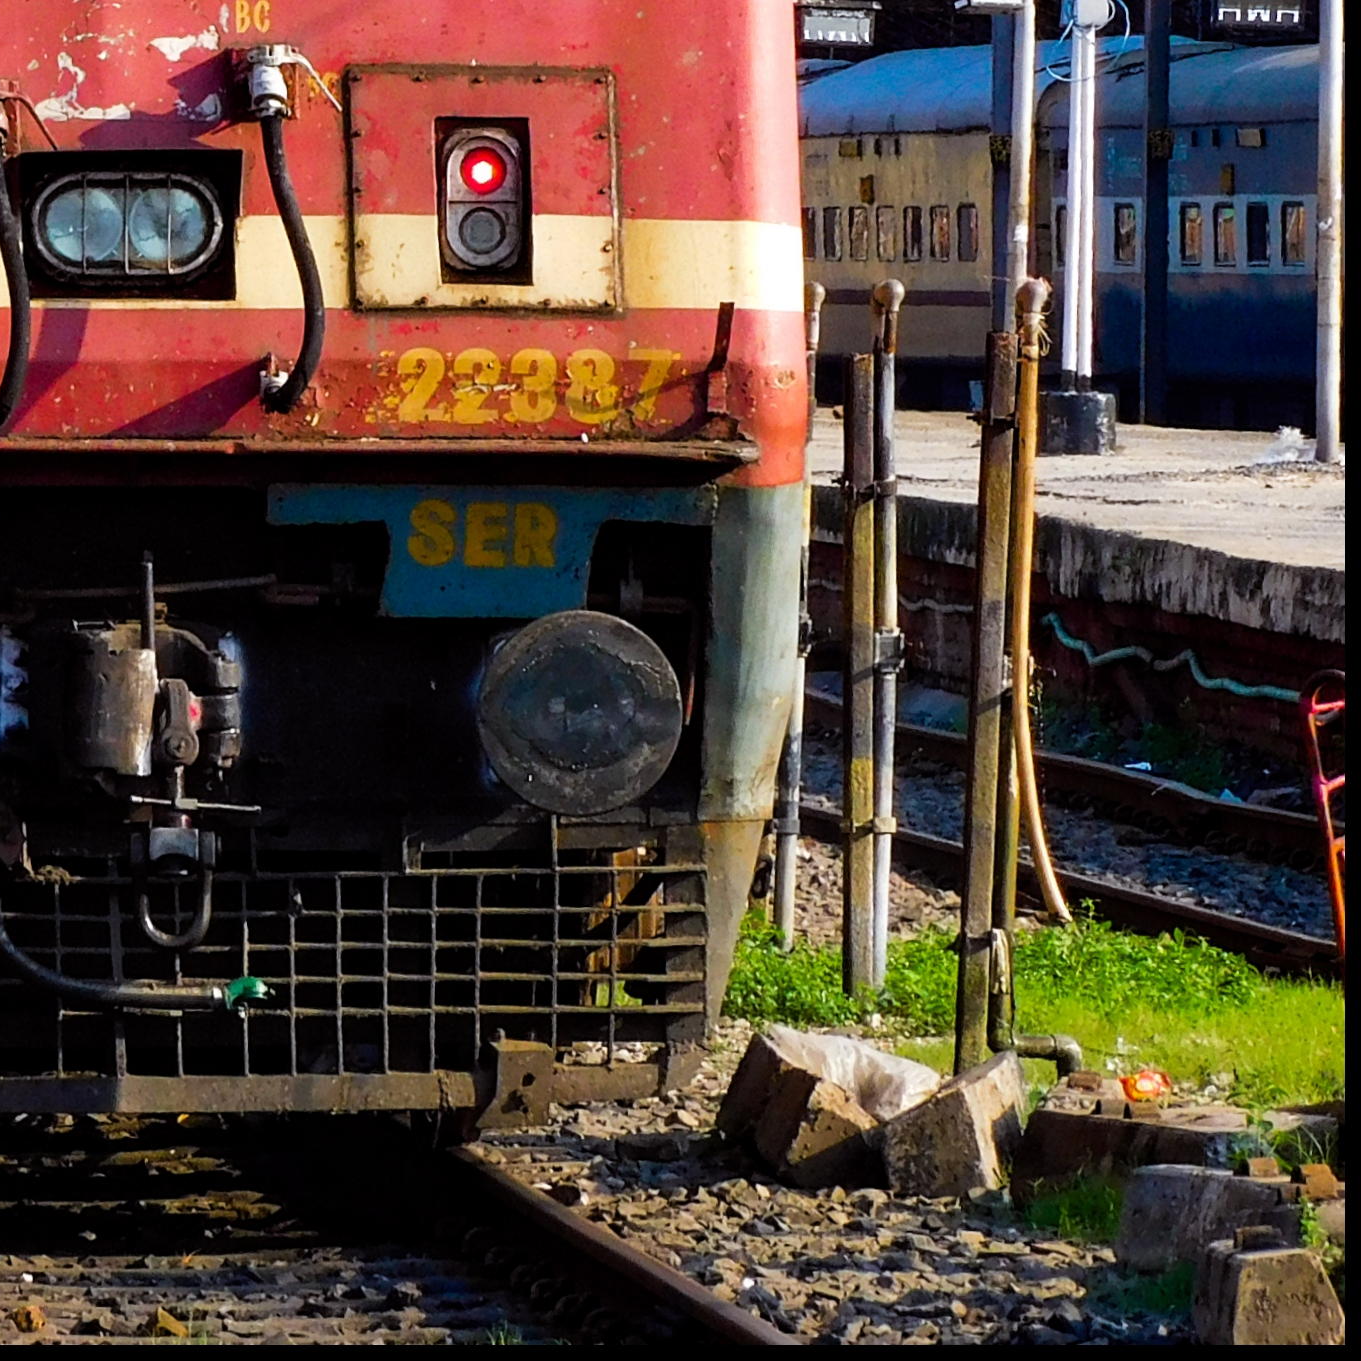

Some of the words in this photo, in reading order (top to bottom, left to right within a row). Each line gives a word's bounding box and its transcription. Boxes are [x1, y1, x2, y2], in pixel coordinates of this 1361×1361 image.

[234, 0, 271, 34] BC
[397, 347, 683, 425] 22387
[407, 498, 559, 568] SER
